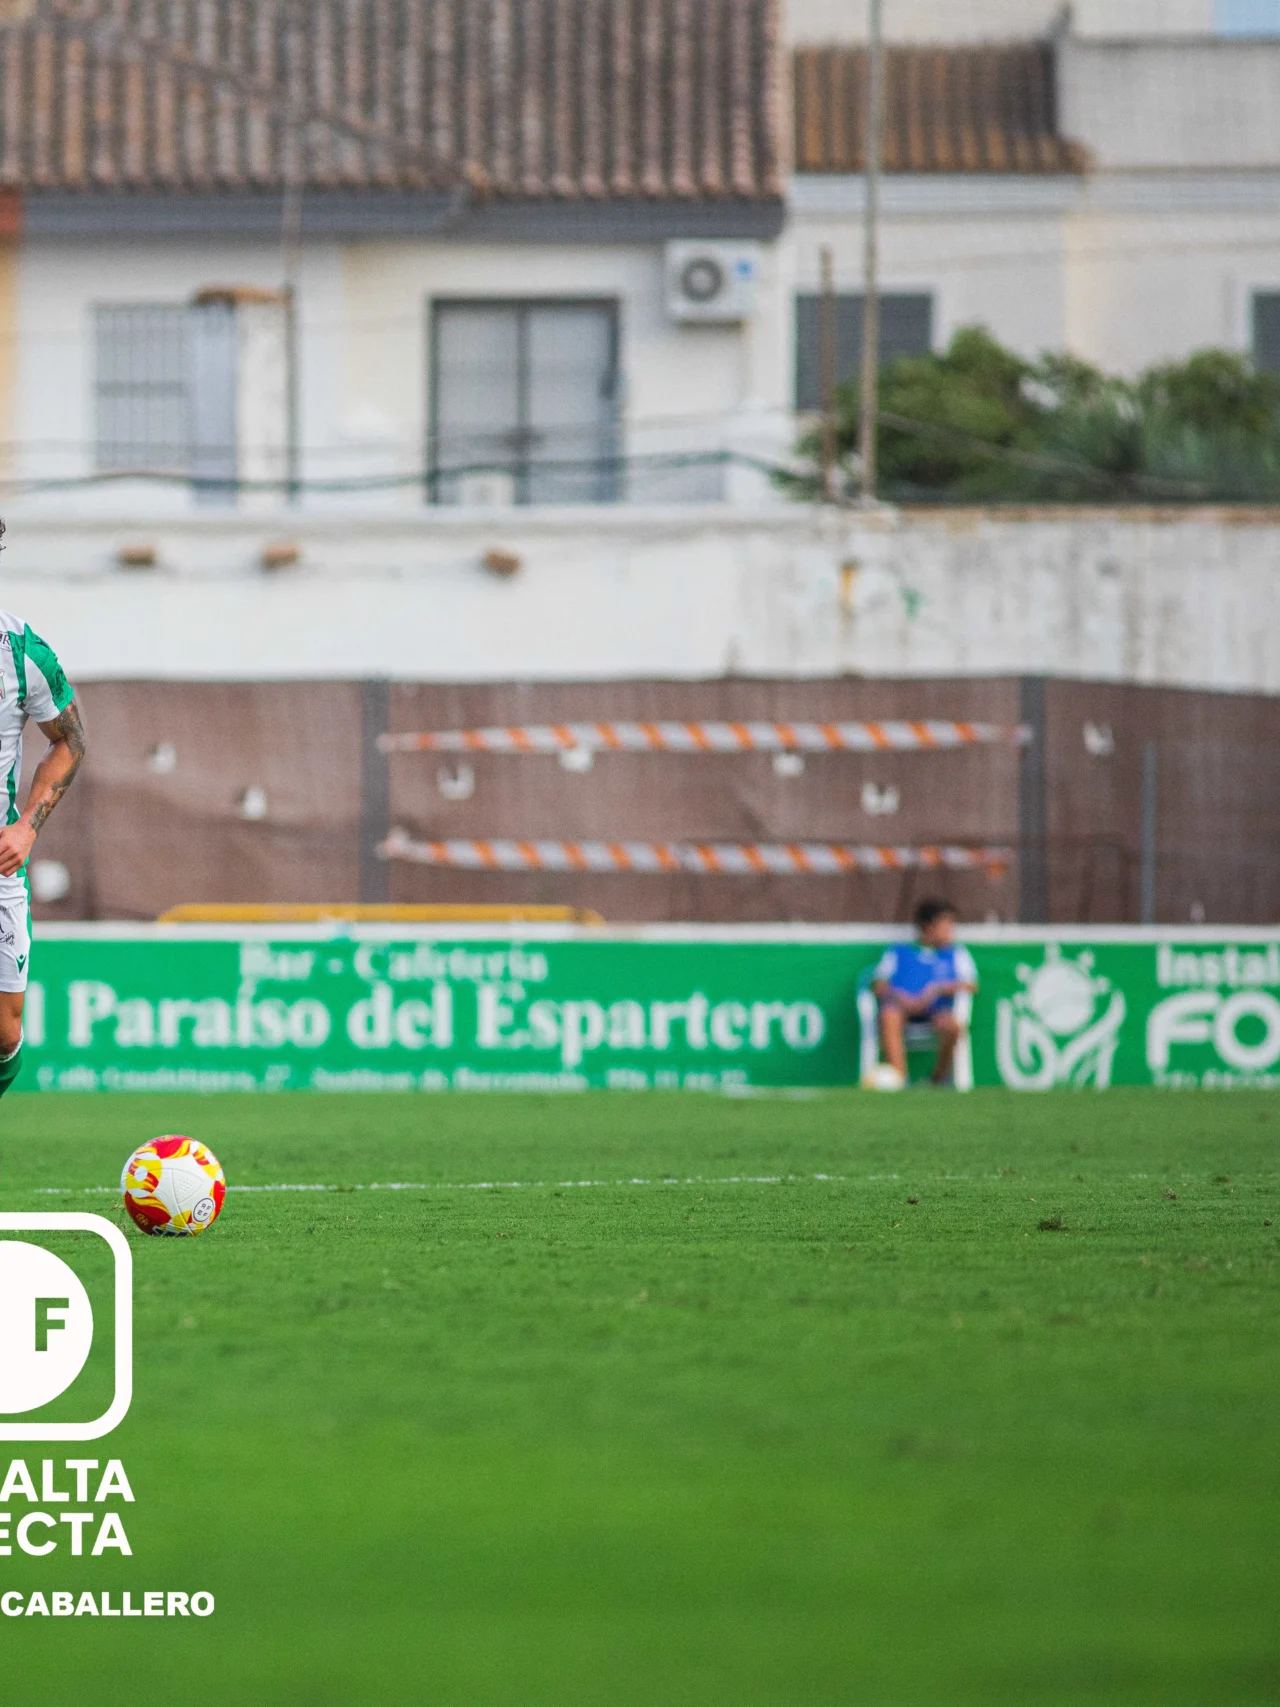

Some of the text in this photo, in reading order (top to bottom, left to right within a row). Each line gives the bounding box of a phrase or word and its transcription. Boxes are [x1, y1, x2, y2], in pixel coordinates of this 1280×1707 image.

[239, 942, 315, 981] Bar
[67, 978, 331, 1049] Paraíso
[346, 980, 454, 1050] del
[475, 980, 826, 1070] Espartero
